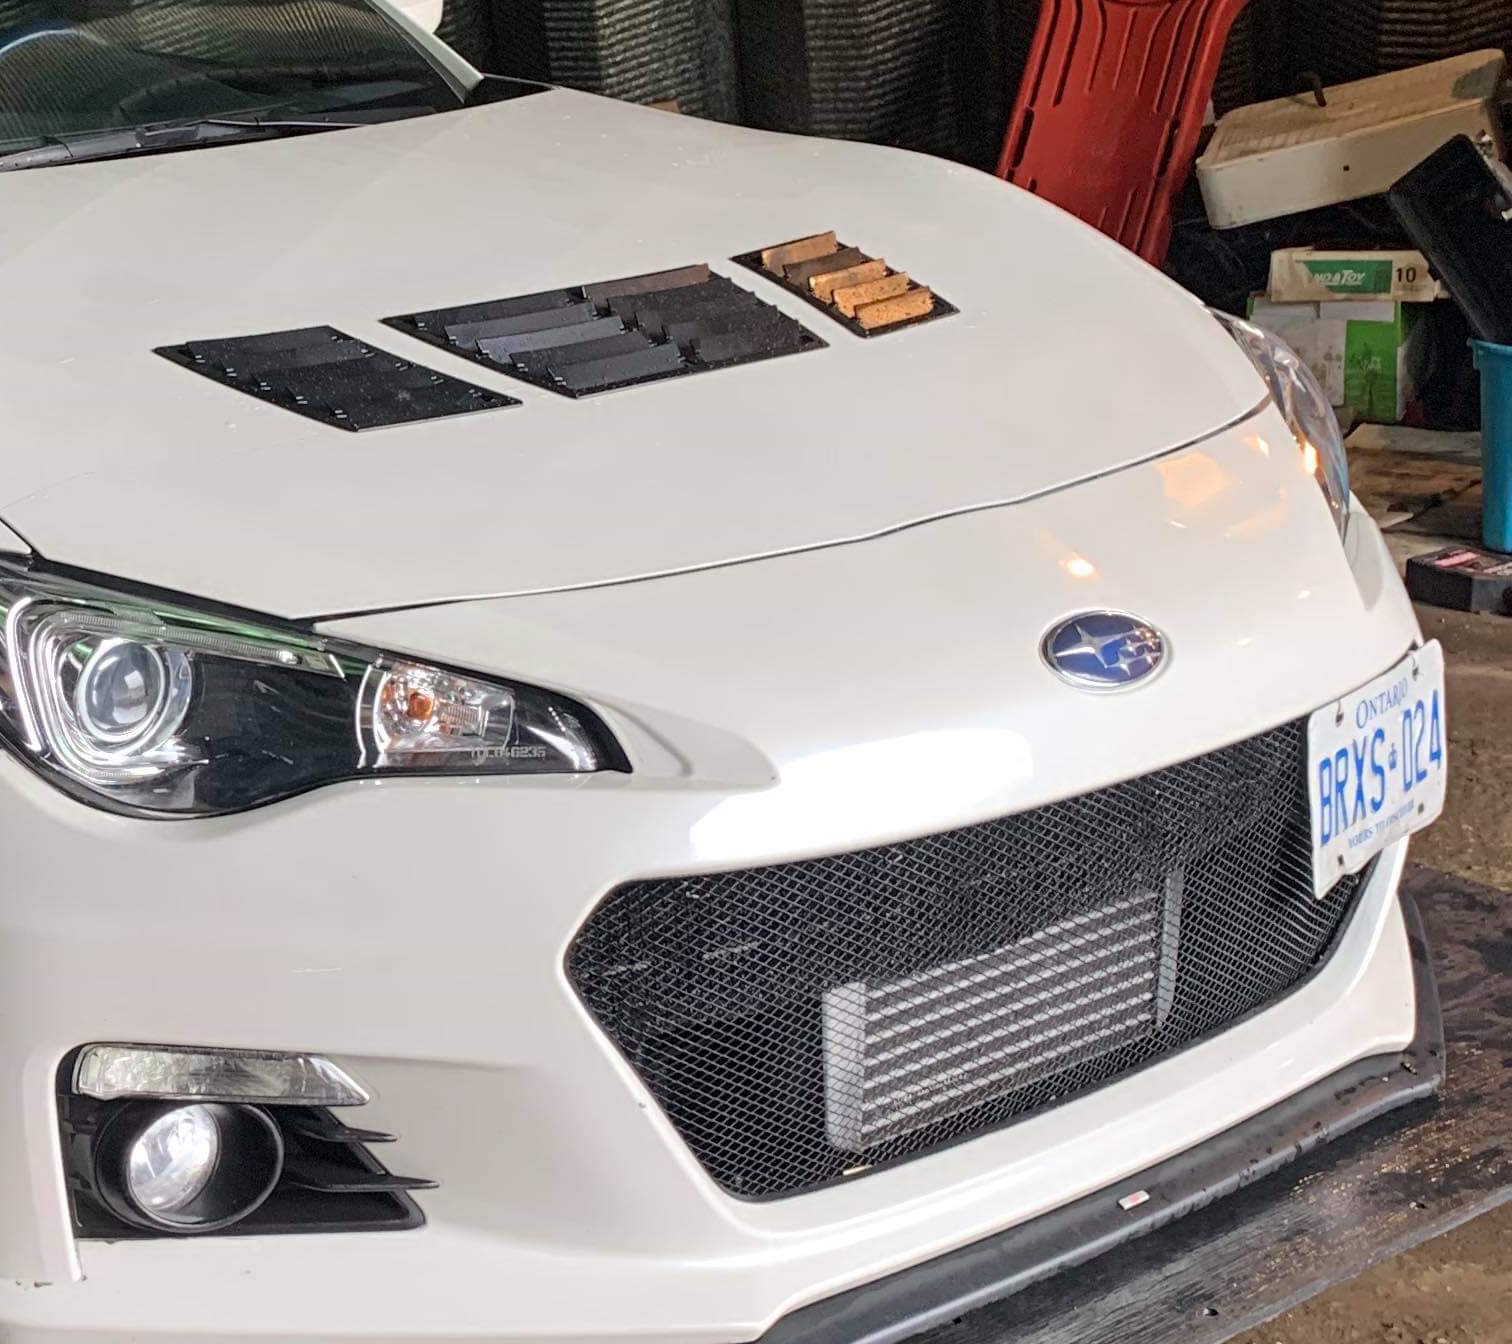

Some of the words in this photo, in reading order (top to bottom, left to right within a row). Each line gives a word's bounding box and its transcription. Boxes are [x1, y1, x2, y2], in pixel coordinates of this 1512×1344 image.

[1396, 267, 1416, 283] 10
[1318, 727, 1386, 847] BRXS
[1401, 688, 1442, 793] 024
